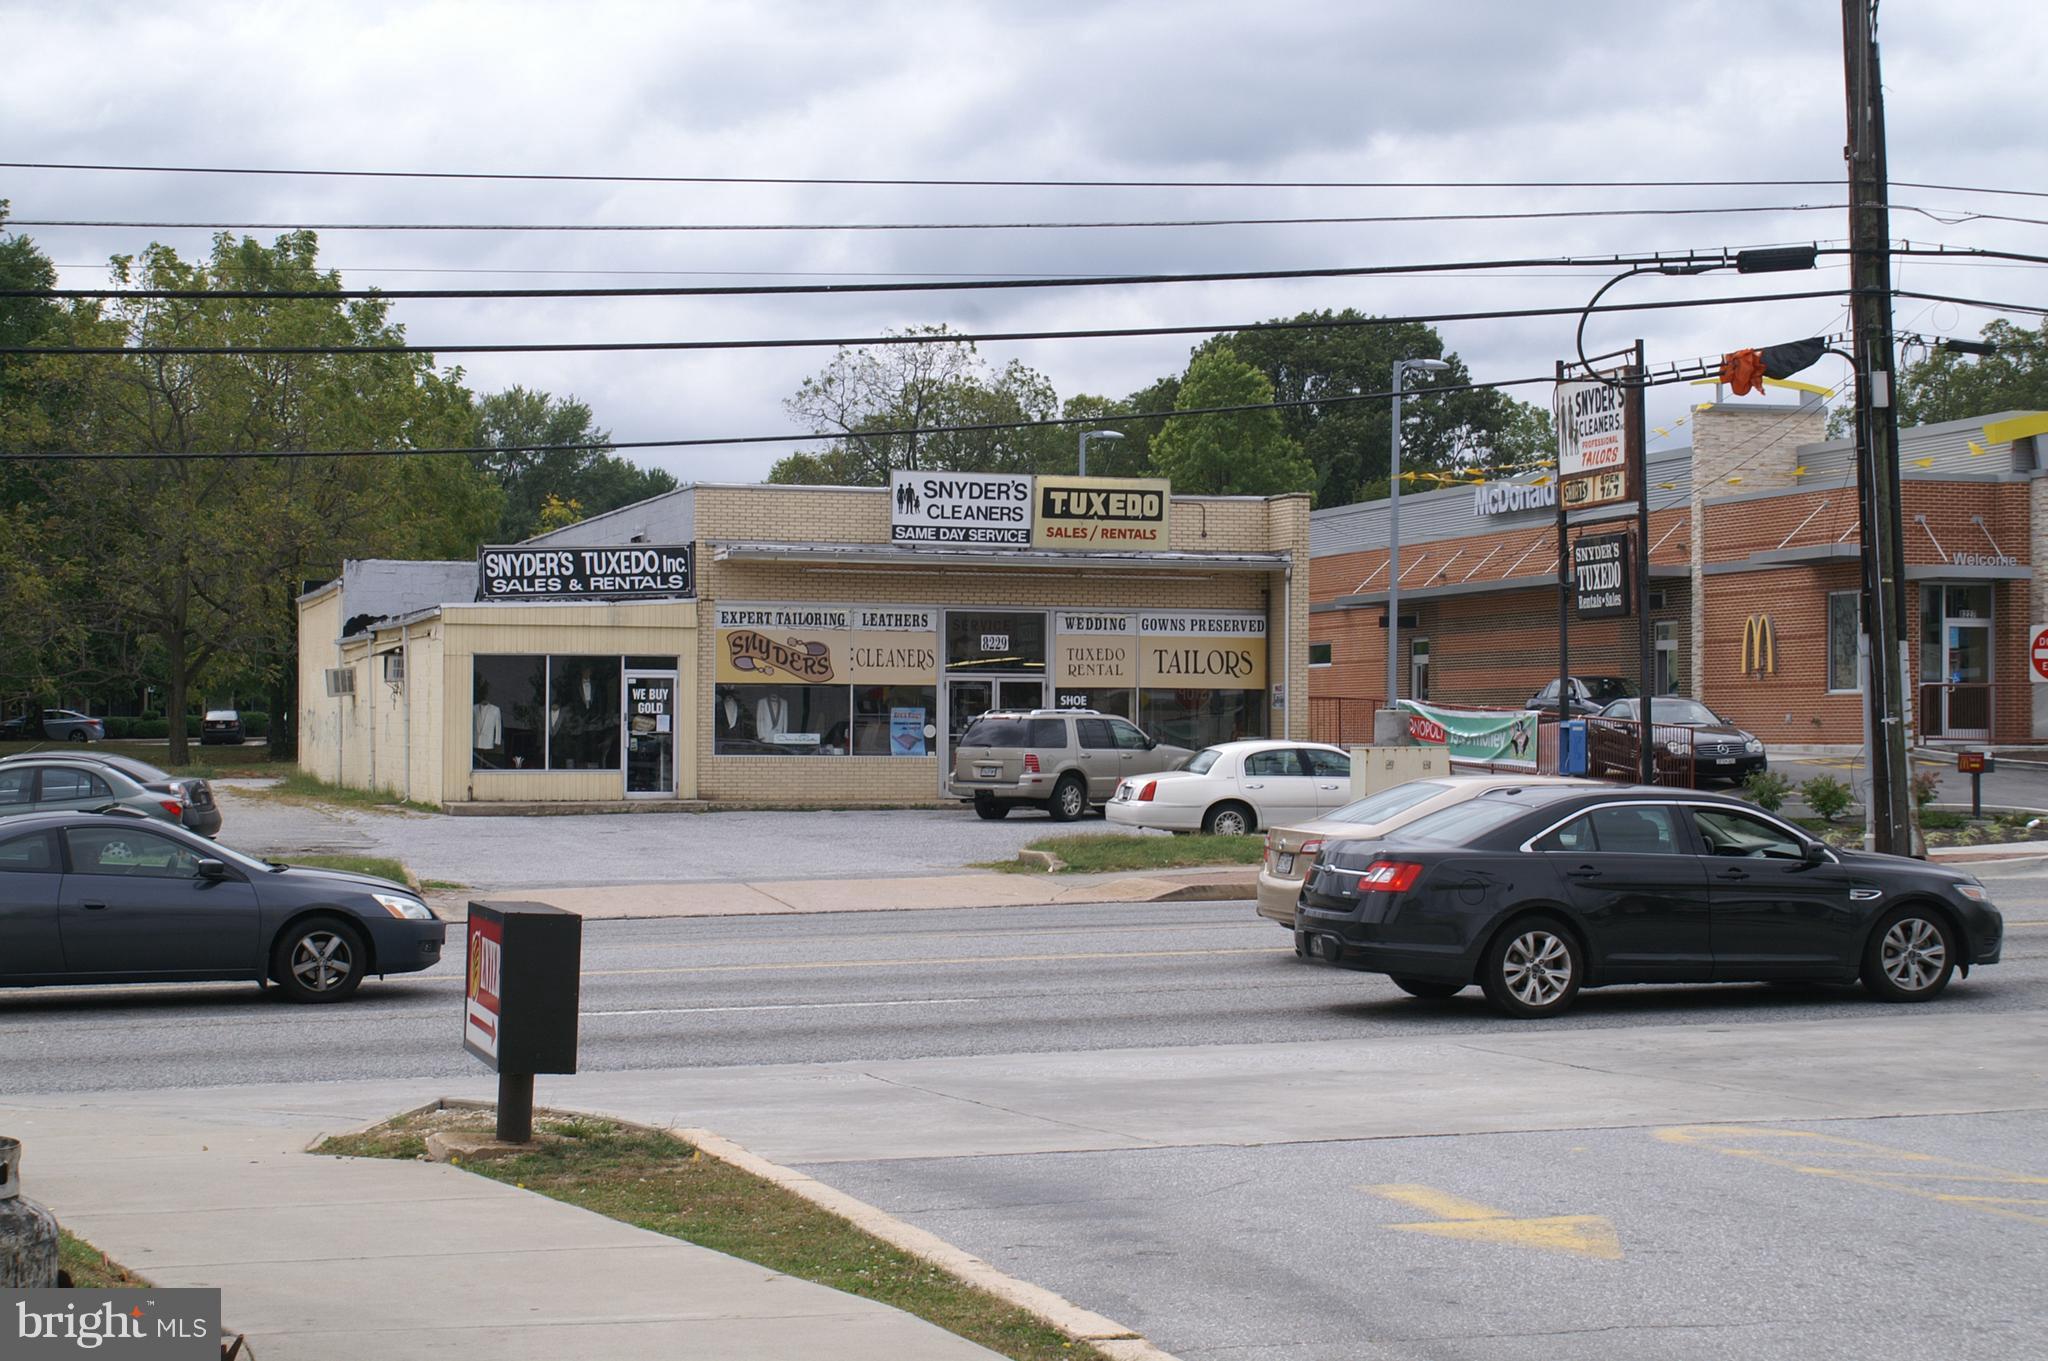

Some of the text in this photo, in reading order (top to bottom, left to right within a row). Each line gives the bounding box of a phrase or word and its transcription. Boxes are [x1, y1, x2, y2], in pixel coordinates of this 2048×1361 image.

[1575, 380, 1625, 418] SNYDER'S
[1579, 413, 1620, 437] CLEANERS
[1582, 435, 1618, 448] PROFESSIONAL
[1582, 447, 1618, 466] TAILORS
[1600, 473, 1619, 485] OPEN
[923, 480, 1028, 501] SNYDER'S
[1600, 486, 1606, 498] 7
[1613, 484, 1619, 496] 7
[1050, 491, 1159, 517] TUXEDO
[927, 504, 1024, 522] CLEANERS
[895, 526, 1027, 543] SAME DAY SERVICE
[1046, 526, 1088, 539] SALES
[1101, 528, 1157, 541] RENTALS
[1575, 542, 1620, 562] SNYDER'S
[486, 551, 573, 577] SNYDER'S
[662, 554, 687, 573] Inc.
[492, 574, 684, 593] SALES & RENTALS
[1577, 561, 1621, 591] TUXEDO
[721, 611, 845, 627] EXPERT TAILORING
[862, 613, 929, 628] LEATHERS
[1065, 616, 1127, 631] WEDDING
[1141, 617, 1265, 633] GOWNS PRESERVED
[982, 636, 1007, 650] 8229
[856, 648, 935, 672] CLEANERS
[1066, 647, 1126, 661] TUXEDO
[1067, 663, 1124, 677] RENTAL
[1153, 649, 1254, 678] TAILORS
[632, 688, 669, 700] WE BUY
[1060, 695, 1088, 706] SHOE
[637, 702, 664, 714] GOLD
